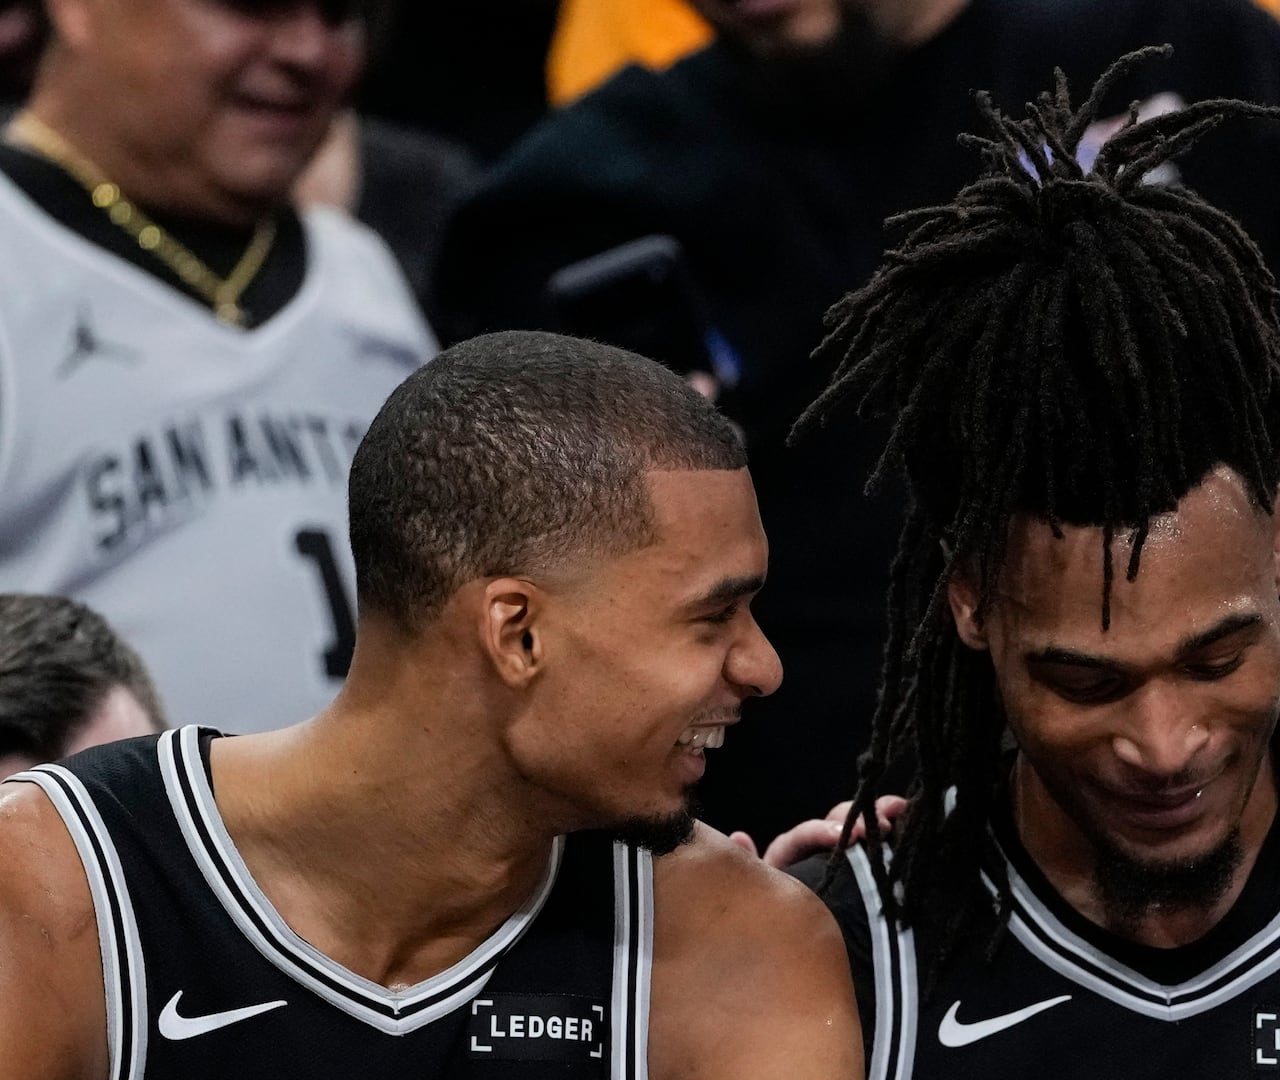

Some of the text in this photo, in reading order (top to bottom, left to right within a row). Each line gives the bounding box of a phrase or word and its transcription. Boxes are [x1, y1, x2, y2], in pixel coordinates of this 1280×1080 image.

[88, 413, 366, 547] SAN ANT
[490, 1014, 593, 1042] LEDGER
